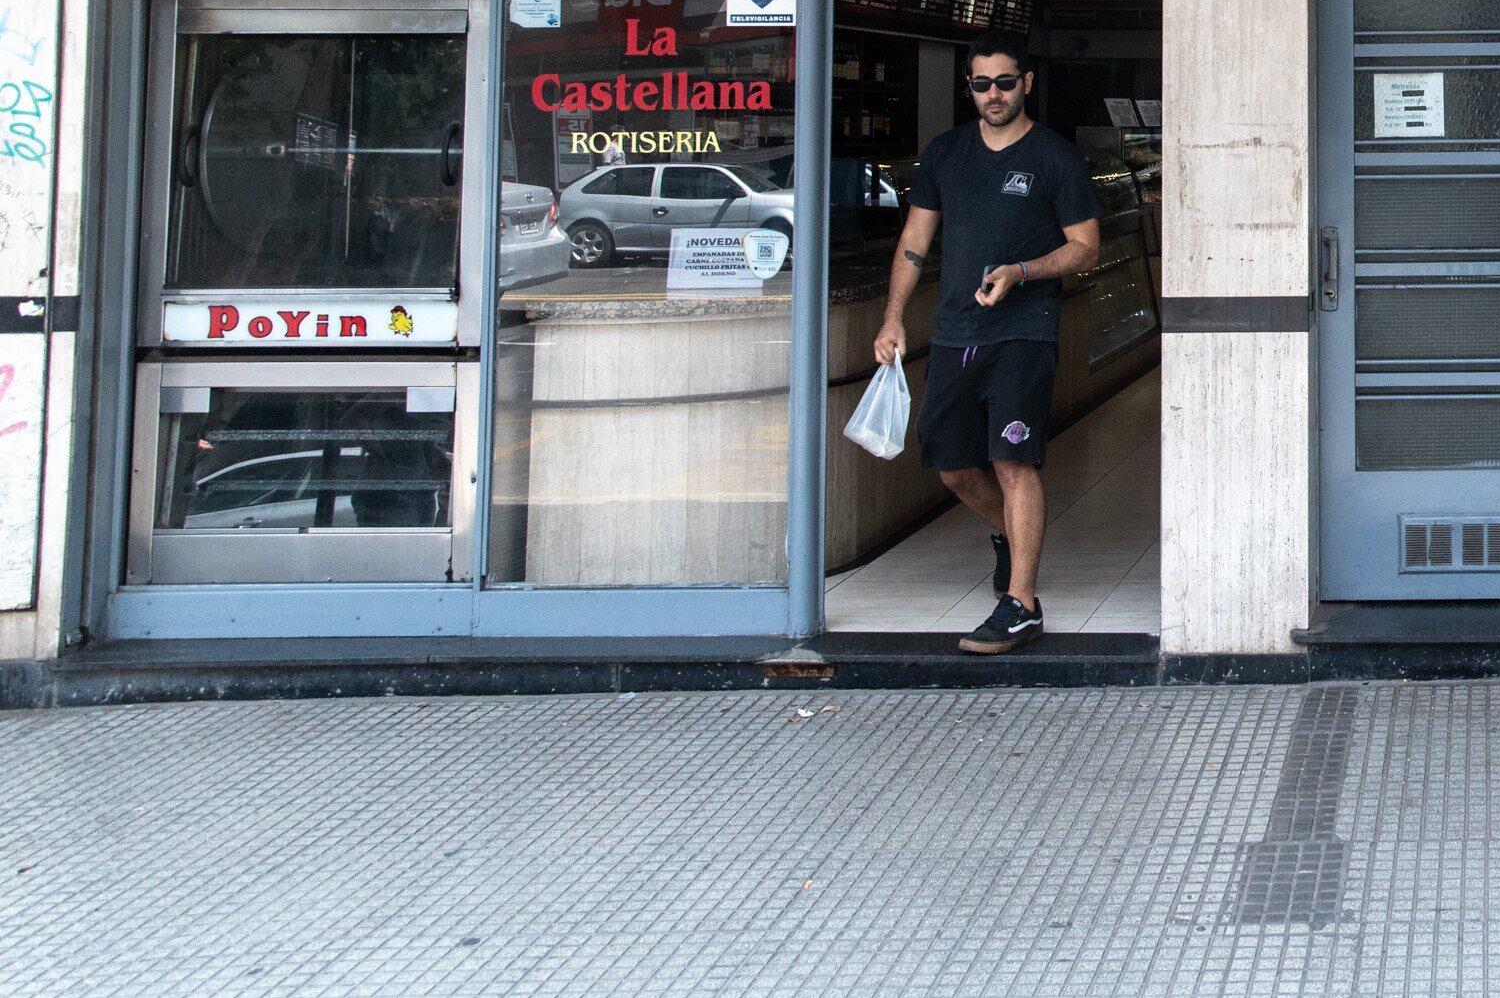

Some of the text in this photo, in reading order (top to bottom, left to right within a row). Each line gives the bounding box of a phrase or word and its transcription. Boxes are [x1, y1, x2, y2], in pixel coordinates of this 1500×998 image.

[625, 18, 678, 56] La
[531, 71, 774, 112] Castellana
[570, 131, 722, 154] ROTISERIA
[686, 237, 744, 248] ¡NOVEDA
